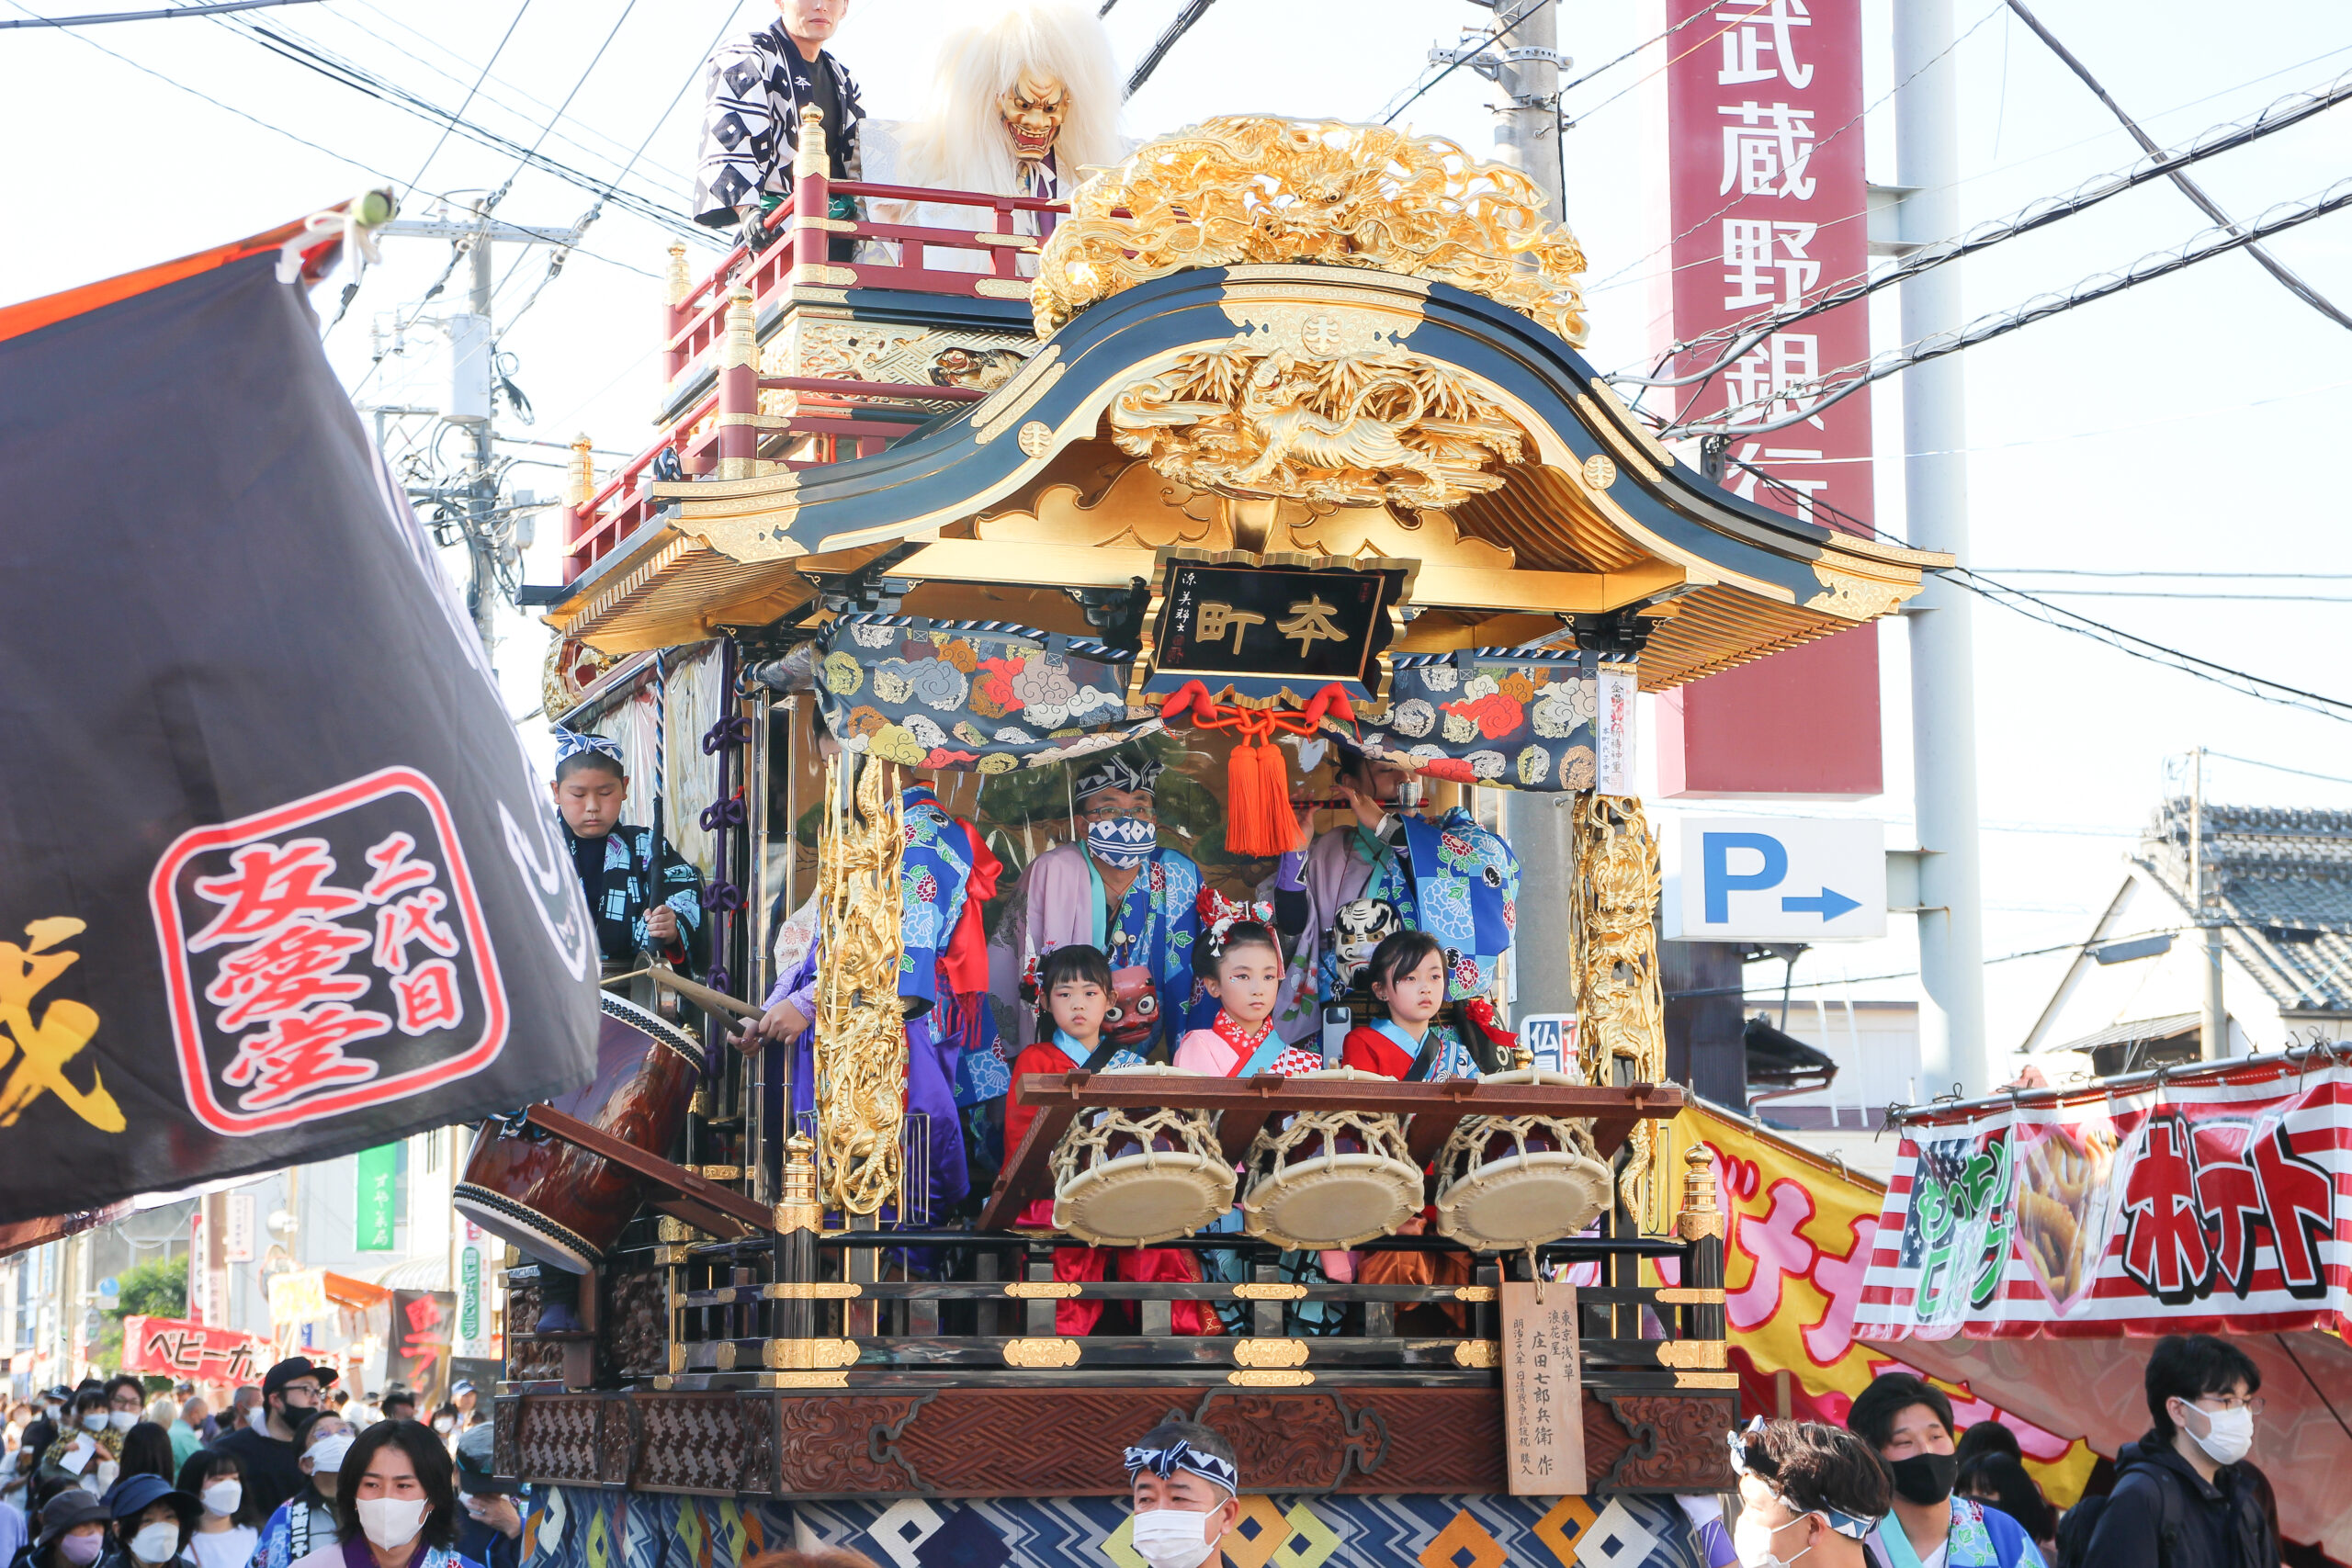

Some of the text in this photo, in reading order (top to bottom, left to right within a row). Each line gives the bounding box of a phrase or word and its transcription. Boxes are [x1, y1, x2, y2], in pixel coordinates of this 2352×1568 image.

[1714, 0, 1828, 522] 武蔵野銀行
[1195, 593, 1349, 658] 本町
[1703, 832, 1789, 924] P
[188, 839, 390, 1110] 友愛堂
[365, 833, 459, 1034] 二代目
[1917, 1126, 2013, 1243] もっちり
[2123, 1112, 2334, 1299] ポテト
[146, 1329, 266, 1382] ベビーカ
[1548, 1310, 1561, 1356] 浪花屋
[1562, 1310, 1575, 1382] 東京浅草
